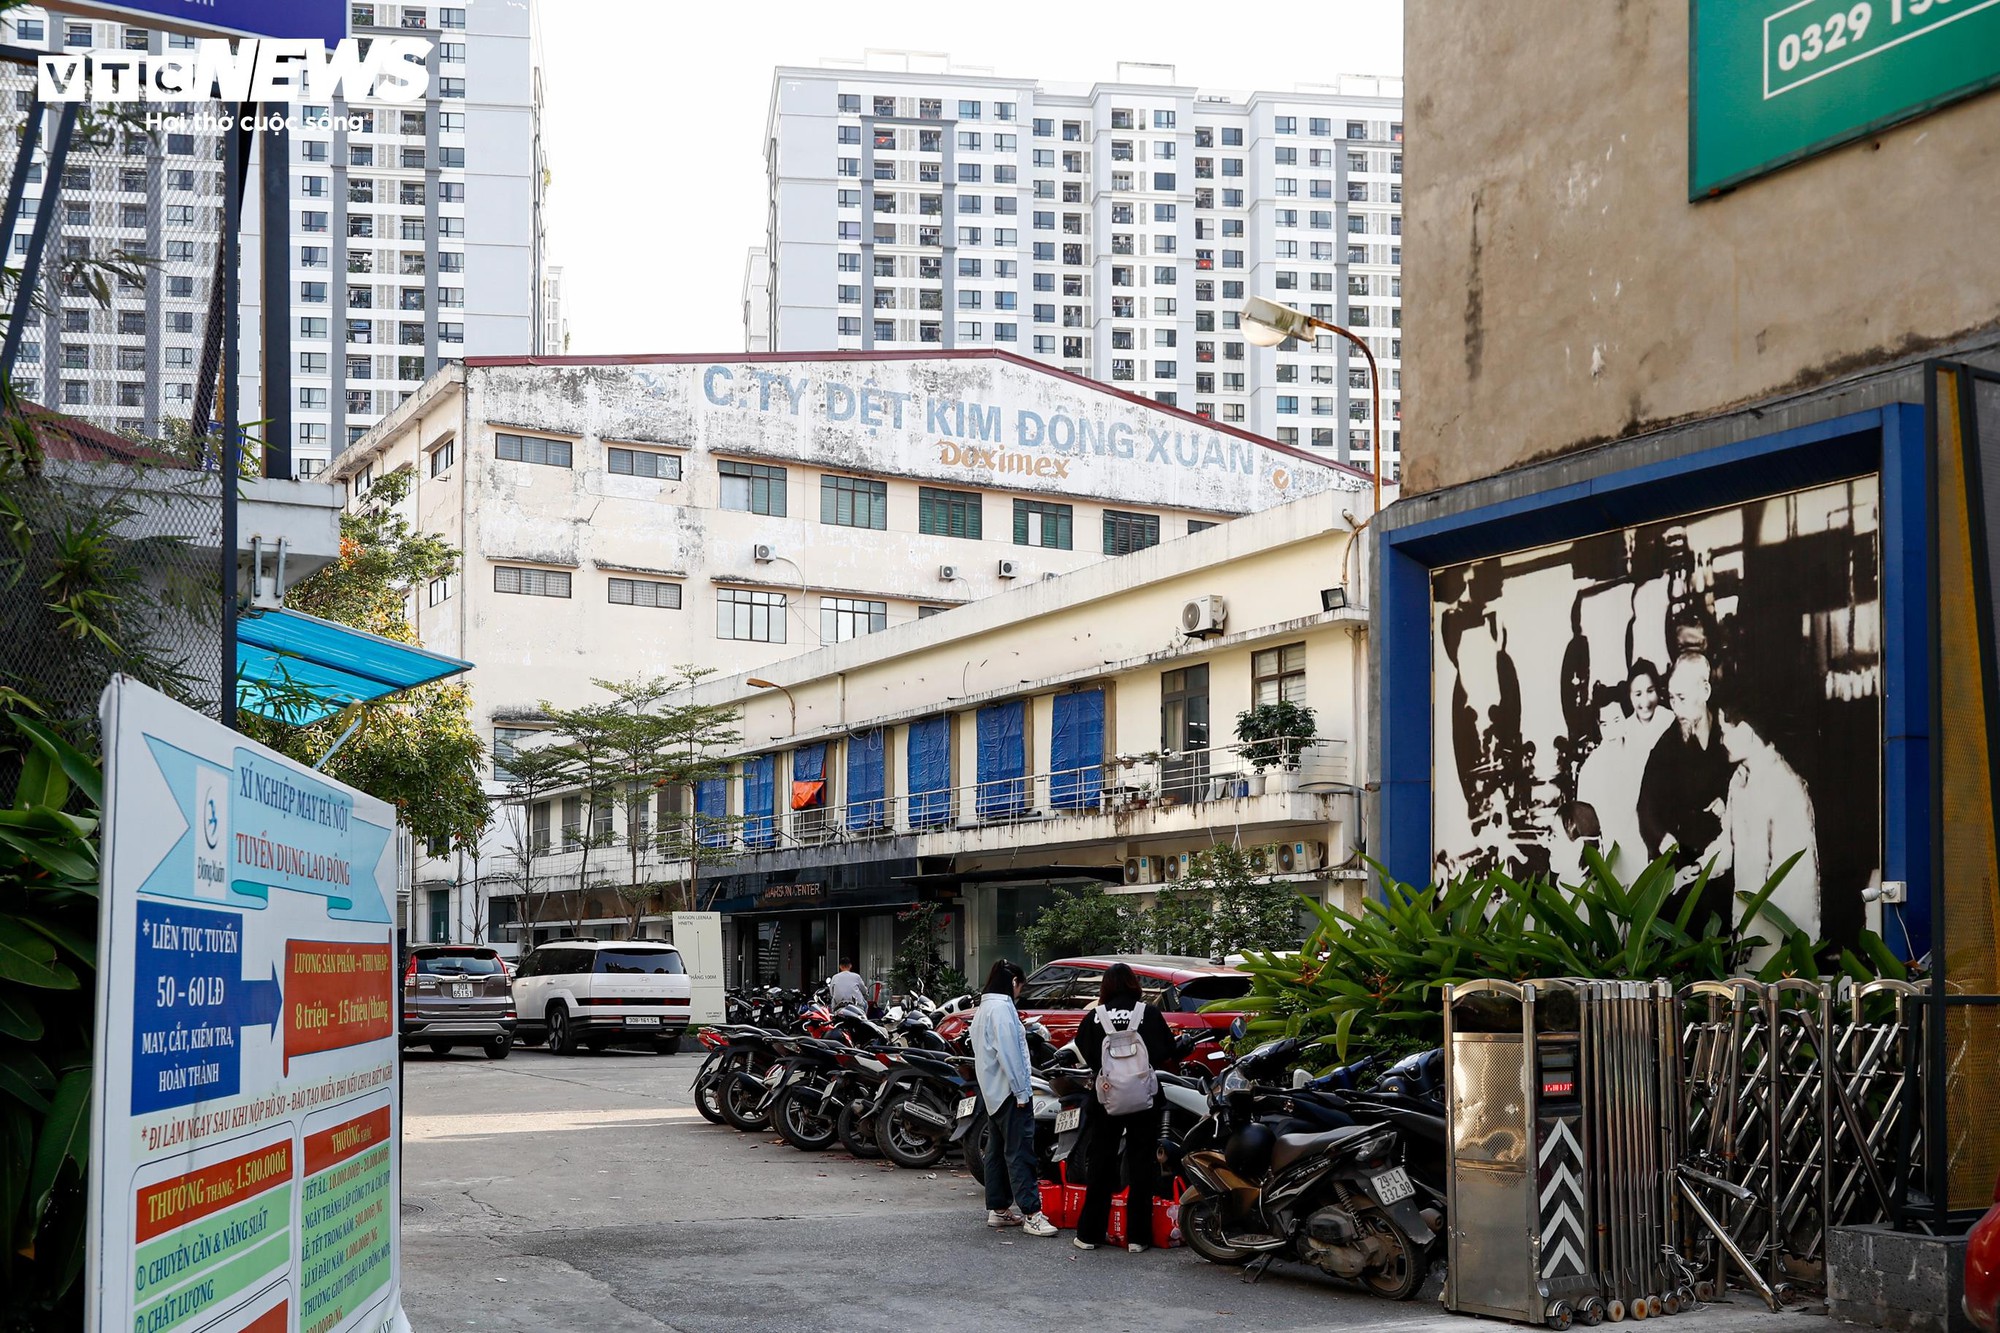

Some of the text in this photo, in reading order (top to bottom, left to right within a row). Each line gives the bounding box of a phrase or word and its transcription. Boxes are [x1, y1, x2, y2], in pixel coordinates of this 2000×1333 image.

[1778, 1, 1872, 71] 0329
[826, 378, 911, 436] DỆT
[926, 397, 1001, 443] KIM
[1015, 404, 1134, 459] ĐÔNG
[937, 438, 1071, 480] Doximex
[240, 762, 348, 837] XÍ NGHIỆP MAY HÀ NỘI
[276, 843, 304, 881] DỤNG
[307, 851, 325, 881] LAO
[326, 852, 350, 891] ĐỘNG
[152, 917, 179, 950] LIÊN
[181, 926, 203, 958] TỤC
[157, 975, 175, 1008] 50
[188, 976, 205, 1007] 60
[207, 976, 224, 1006] LĐ
[295, 1002, 303, 1030] 8
[304, 1000, 328, 1034] triệu
[338, 999, 349, 1025] 15
[141, 1031, 167, 1056] MAY,
[214, 1026, 234, 1048] TRA,
[158, 1059, 219, 1092] HOÀN THÀNH
[149, 1125, 161, 1151] ĐI
[162, 1116, 185, 1147] LÀM
[186, 1113, 213, 1141] NGAY
[212, 1109, 231, 1133] SAU
[231, 1105, 249, 1129] KHI
[249, 1097, 265, 1127] NỘP
[265, 1091, 276, 1118] HỒ
[276, 1095, 287, 1116] SƠ
[291, 1086, 306, 1111] ĐÀO
[306, 1086, 320, 1110] TẠO
[331, 1122, 360, 1154] THƯỞNG
[148, 1147, 287, 1224] THƯỞNG THÁNG: 1.500.000đ
[1377, 1170, 1404, 1189] 29-L1
[1381, 1181, 1413, 1203] 332.98
[149, 1243, 191, 1285] CHUYÊN
[192, 1233, 212, 1264] CẦN
[213, 1232, 222, 1253] &
[222, 1219, 248, 1250] NĂNG
[248, 1205, 268, 1238] SUẤT
[147, 1294, 176, 1333] CHẤT
[178, 1278, 214, 1315] LƯỢNG
